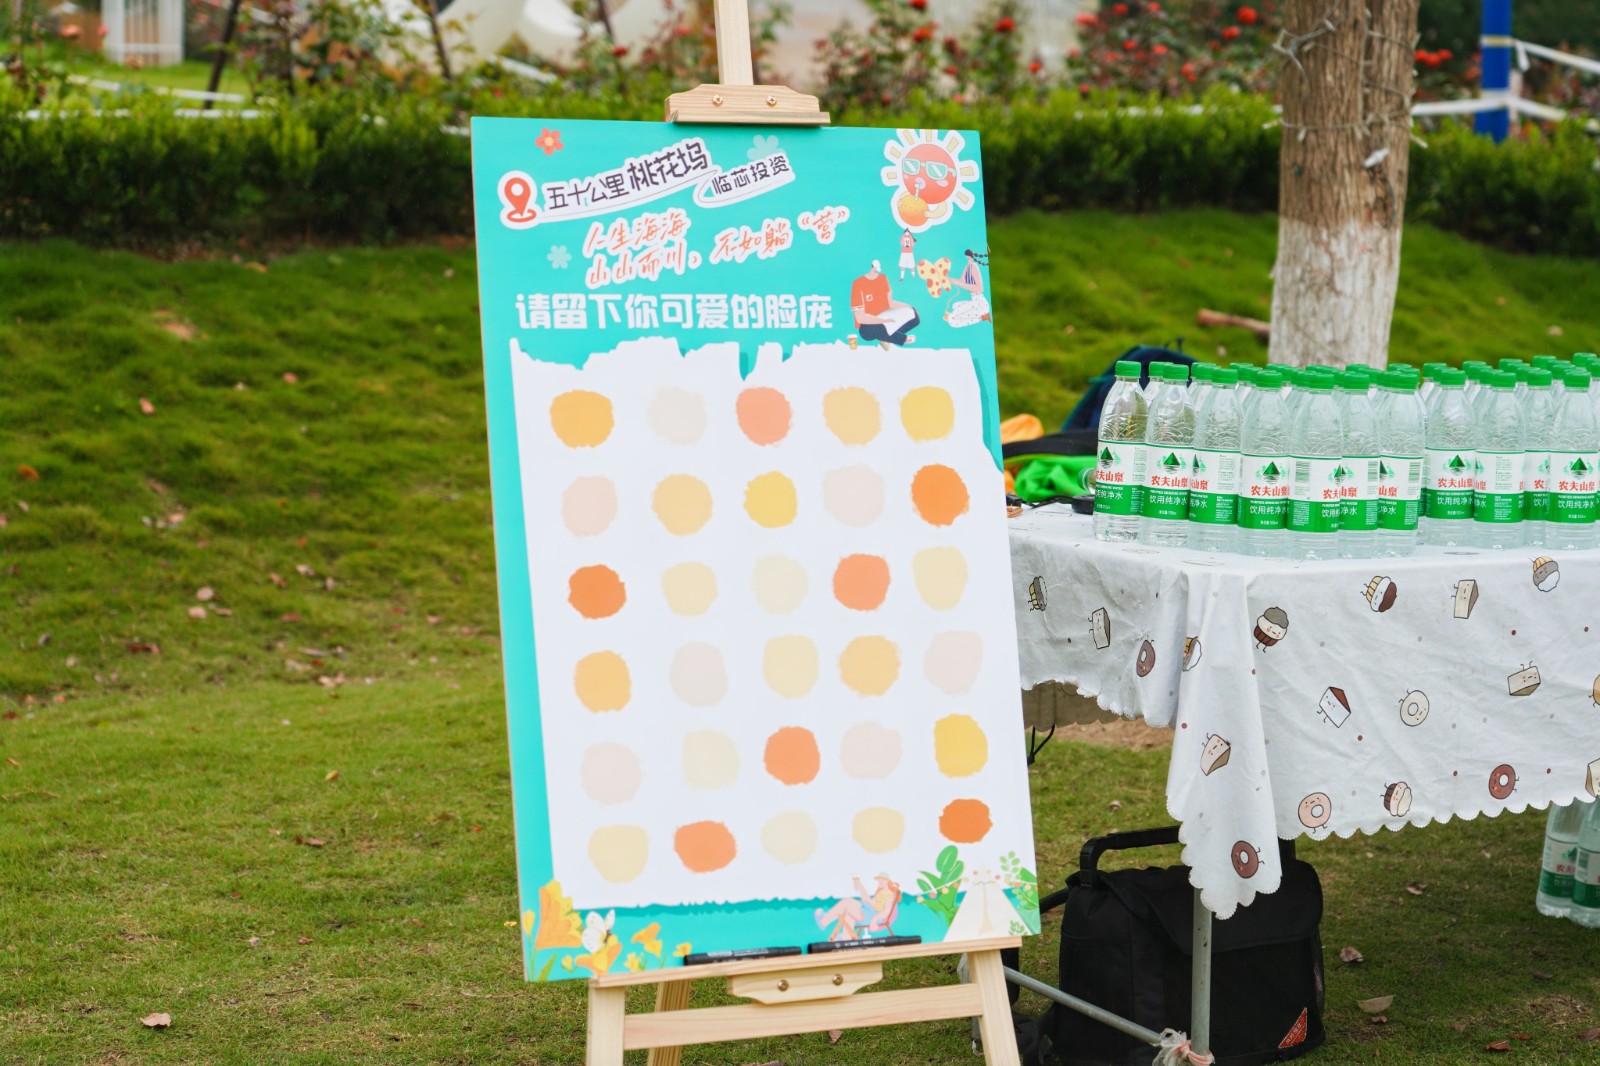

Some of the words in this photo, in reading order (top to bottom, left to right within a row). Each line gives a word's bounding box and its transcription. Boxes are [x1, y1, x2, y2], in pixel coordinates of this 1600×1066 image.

[546, 141, 708, 210] 五十公里桃花坞
[711, 155, 790, 195] 临芯投资
[587, 212, 688, 252] 人生海海
[514, 293, 833, 330] 请留下你可爱的脸庞
[1151, 475, 1189, 488] 农夫山泉
[1558, 480, 1595, 492] 农夫山泉
